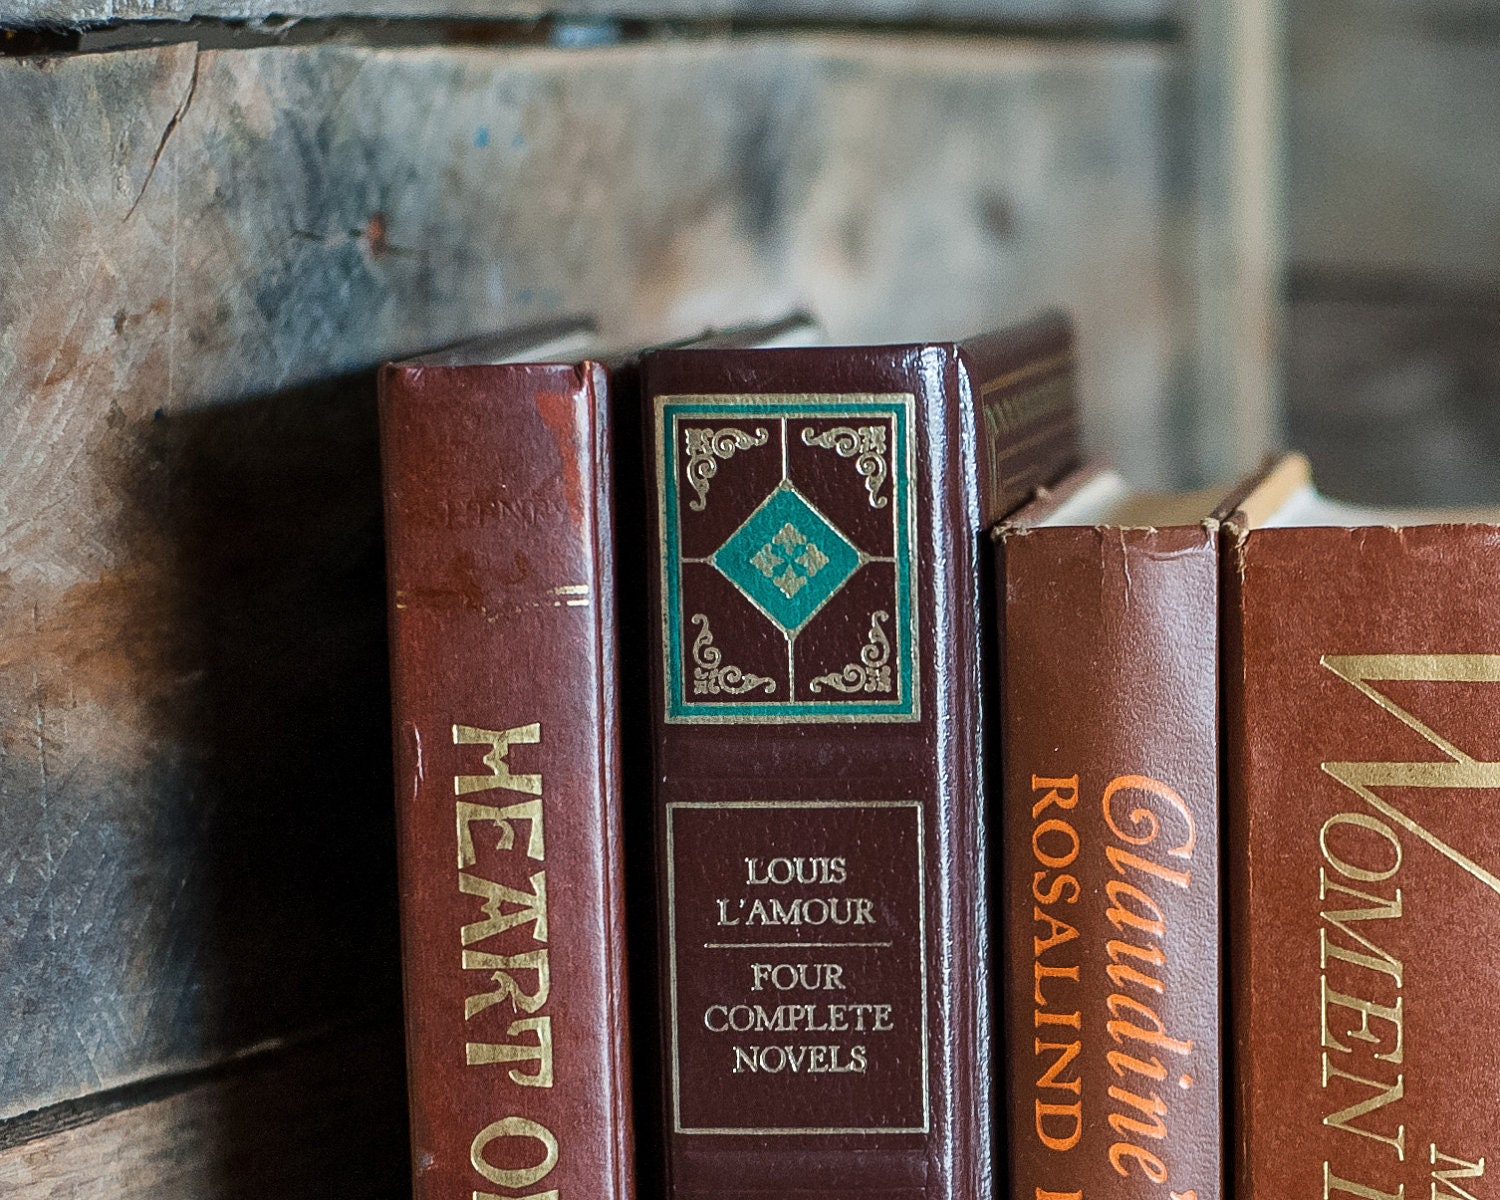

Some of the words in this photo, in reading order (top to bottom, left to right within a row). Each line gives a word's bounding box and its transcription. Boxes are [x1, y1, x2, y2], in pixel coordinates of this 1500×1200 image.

[744, 856, 848, 885] LOUIS
[451, 722, 555, 1090] HEART
[715, 898, 877, 926] L'AMOUR
[750, 963, 847, 991] FOUR
[1031, 773, 1083, 1153] ROSALIND
[703, 1004, 895, 1032] COMPLETE
[731, 1045, 868, 1074] NOVELS
